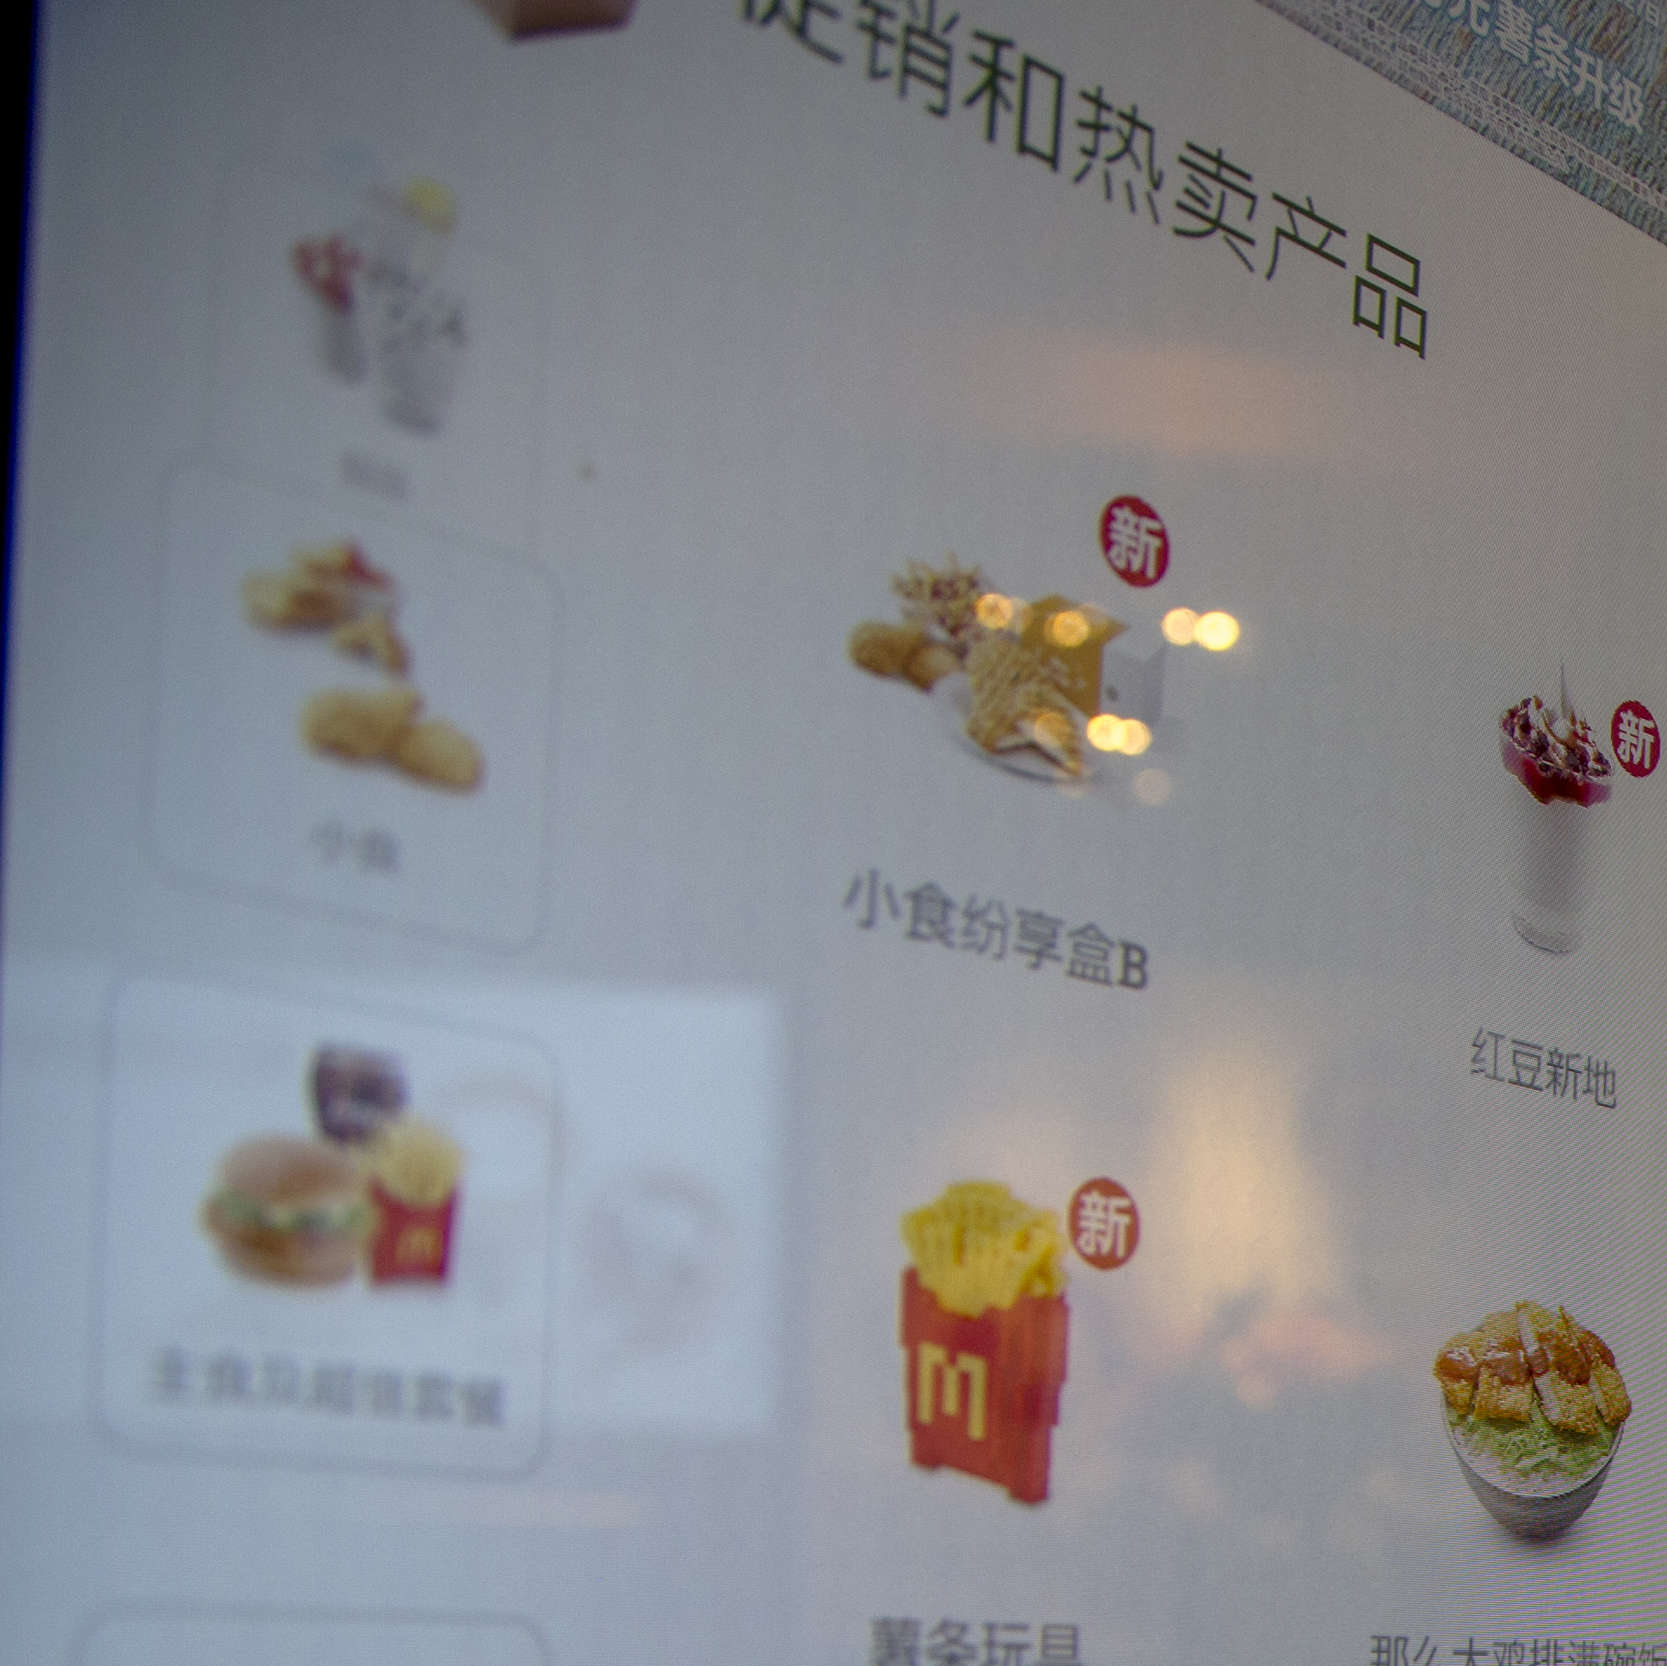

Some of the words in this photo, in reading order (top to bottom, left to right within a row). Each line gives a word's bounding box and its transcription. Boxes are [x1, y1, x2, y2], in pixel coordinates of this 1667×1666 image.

[1108, 506, 1163, 579] 新
[1617, 709, 1656, 770] 新
[843, 868, 1150, 990] 小食纷享盒B
[1470, 1026, 1617, 1109] 红豆新地
[1077, 1190, 1131, 1259] 新
